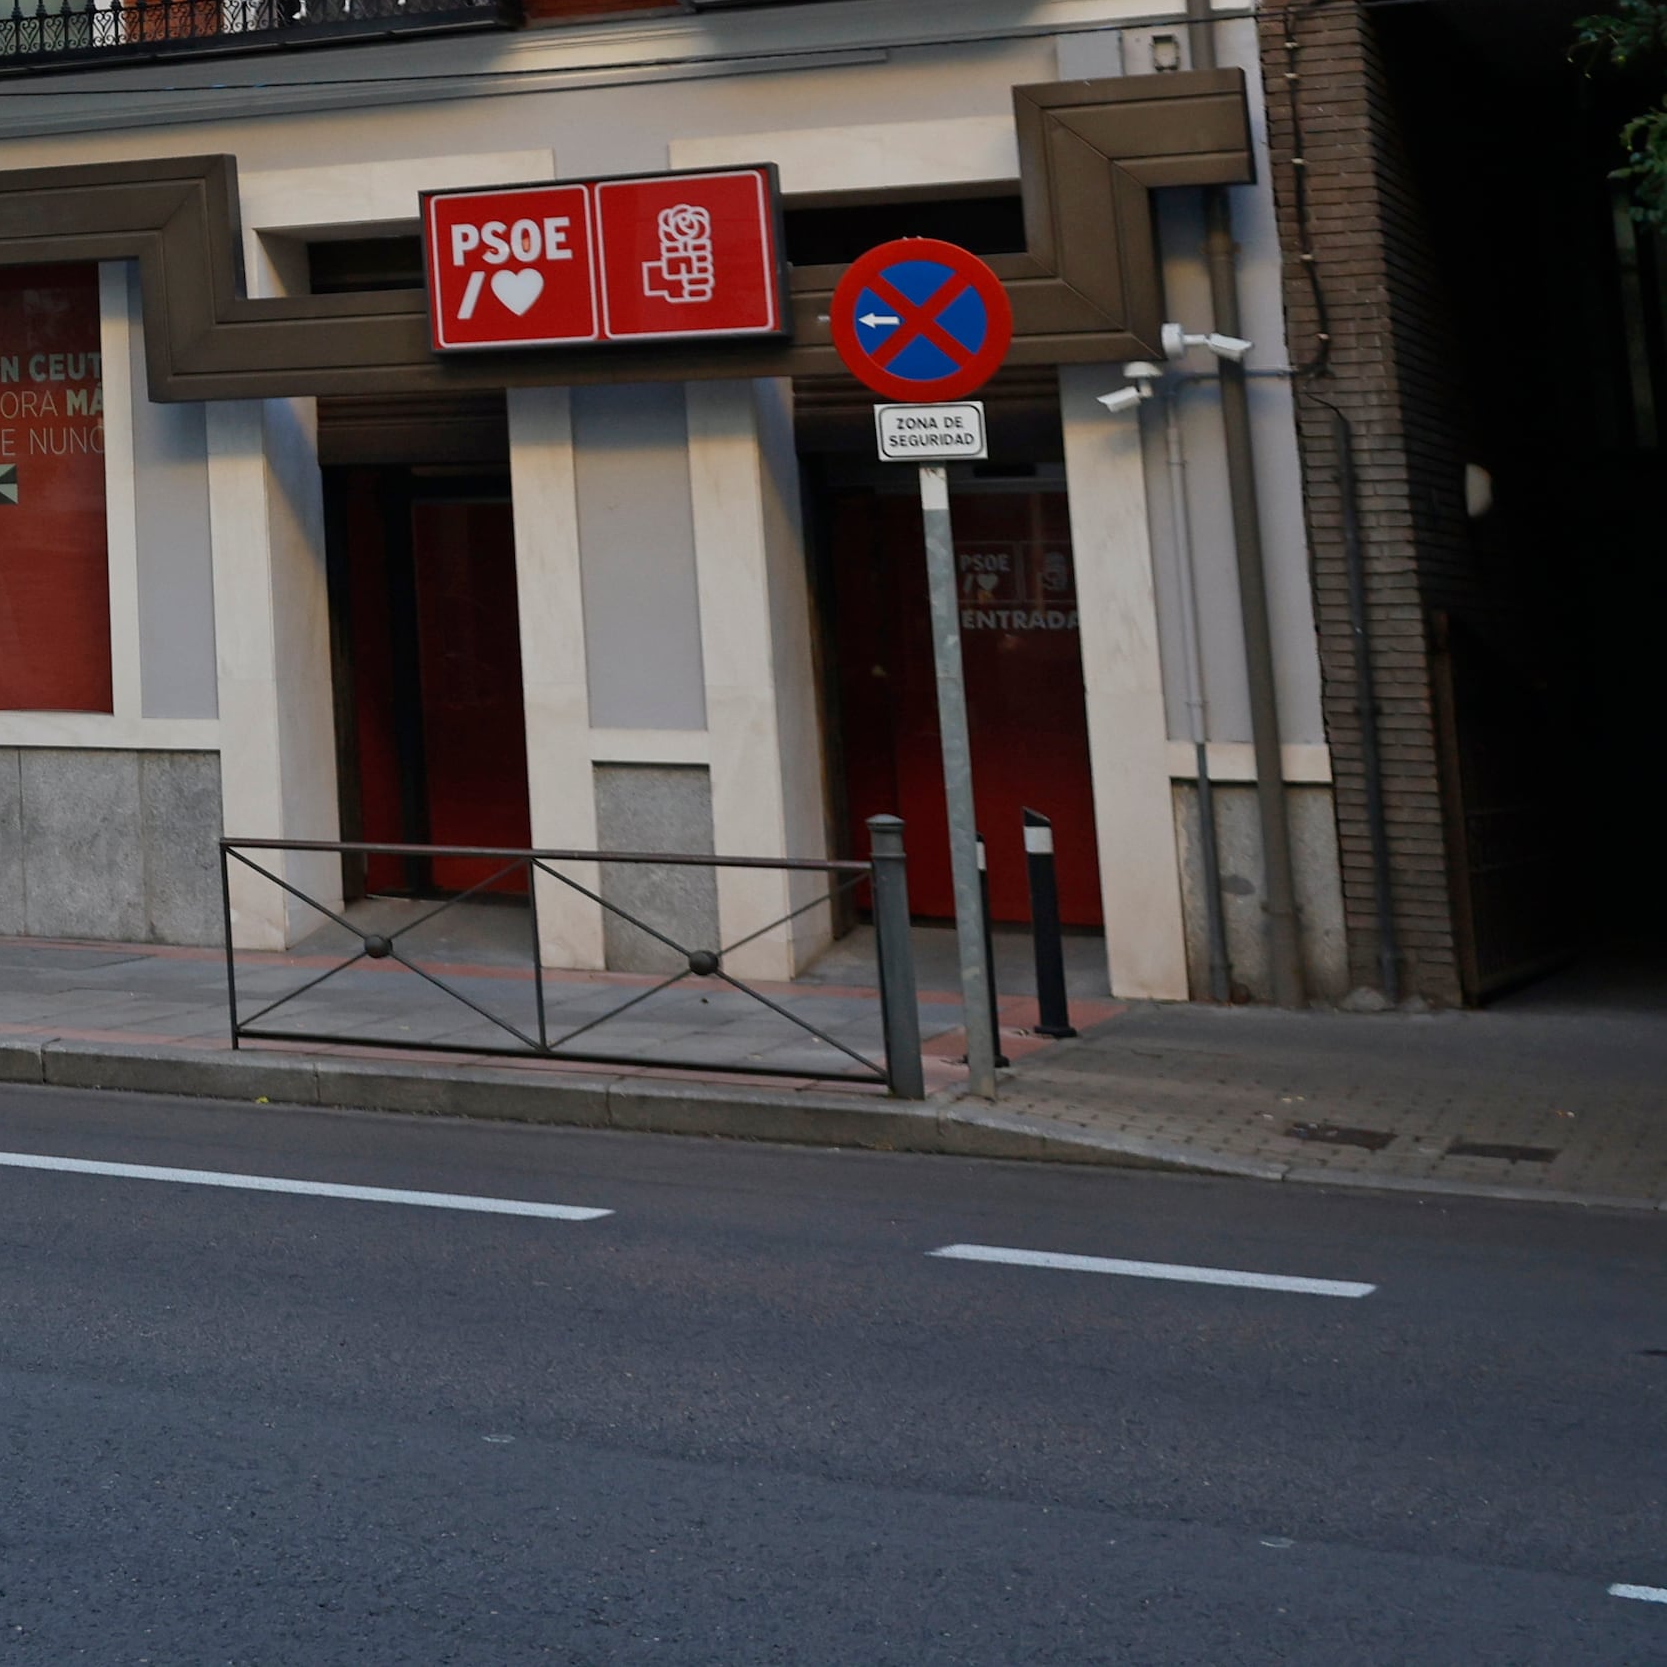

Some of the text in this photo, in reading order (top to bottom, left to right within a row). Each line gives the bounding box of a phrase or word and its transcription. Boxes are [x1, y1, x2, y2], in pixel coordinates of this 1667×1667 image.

[450, 216, 574, 266] PSOE
[896, 415, 964, 430] ZONA DE
[889, 432, 975, 447] SEGURIDAD
[961, 553, 1011, 572] PSOE
